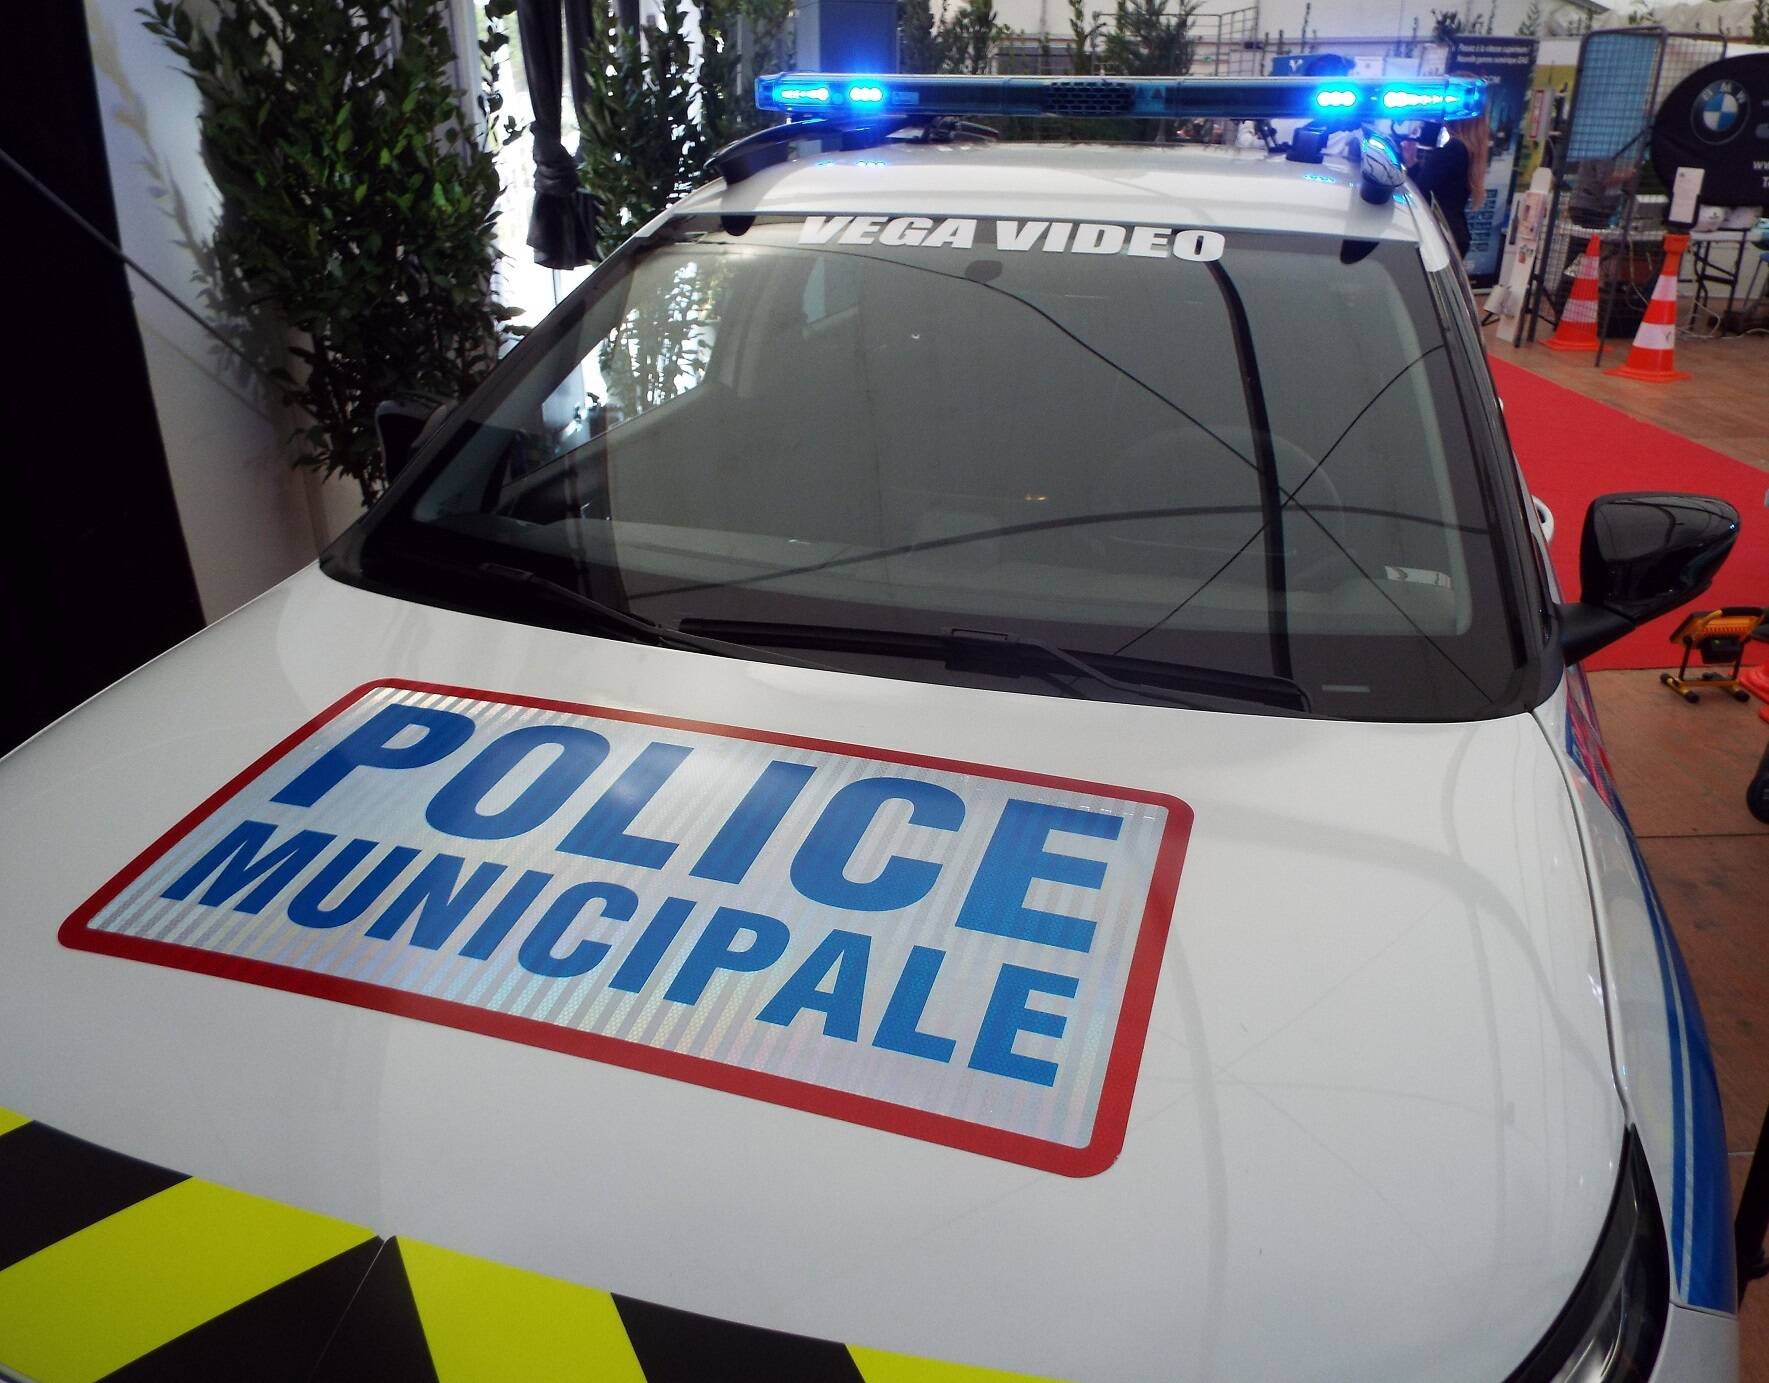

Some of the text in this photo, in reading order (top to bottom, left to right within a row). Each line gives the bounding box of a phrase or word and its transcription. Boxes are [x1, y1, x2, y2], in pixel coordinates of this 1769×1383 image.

[798, 215, 1226, 262] VEGA VIDEO
[161, 818, 1082, 1088] MUNICIPALE
[269, 704, 1124, 954] POLICE
